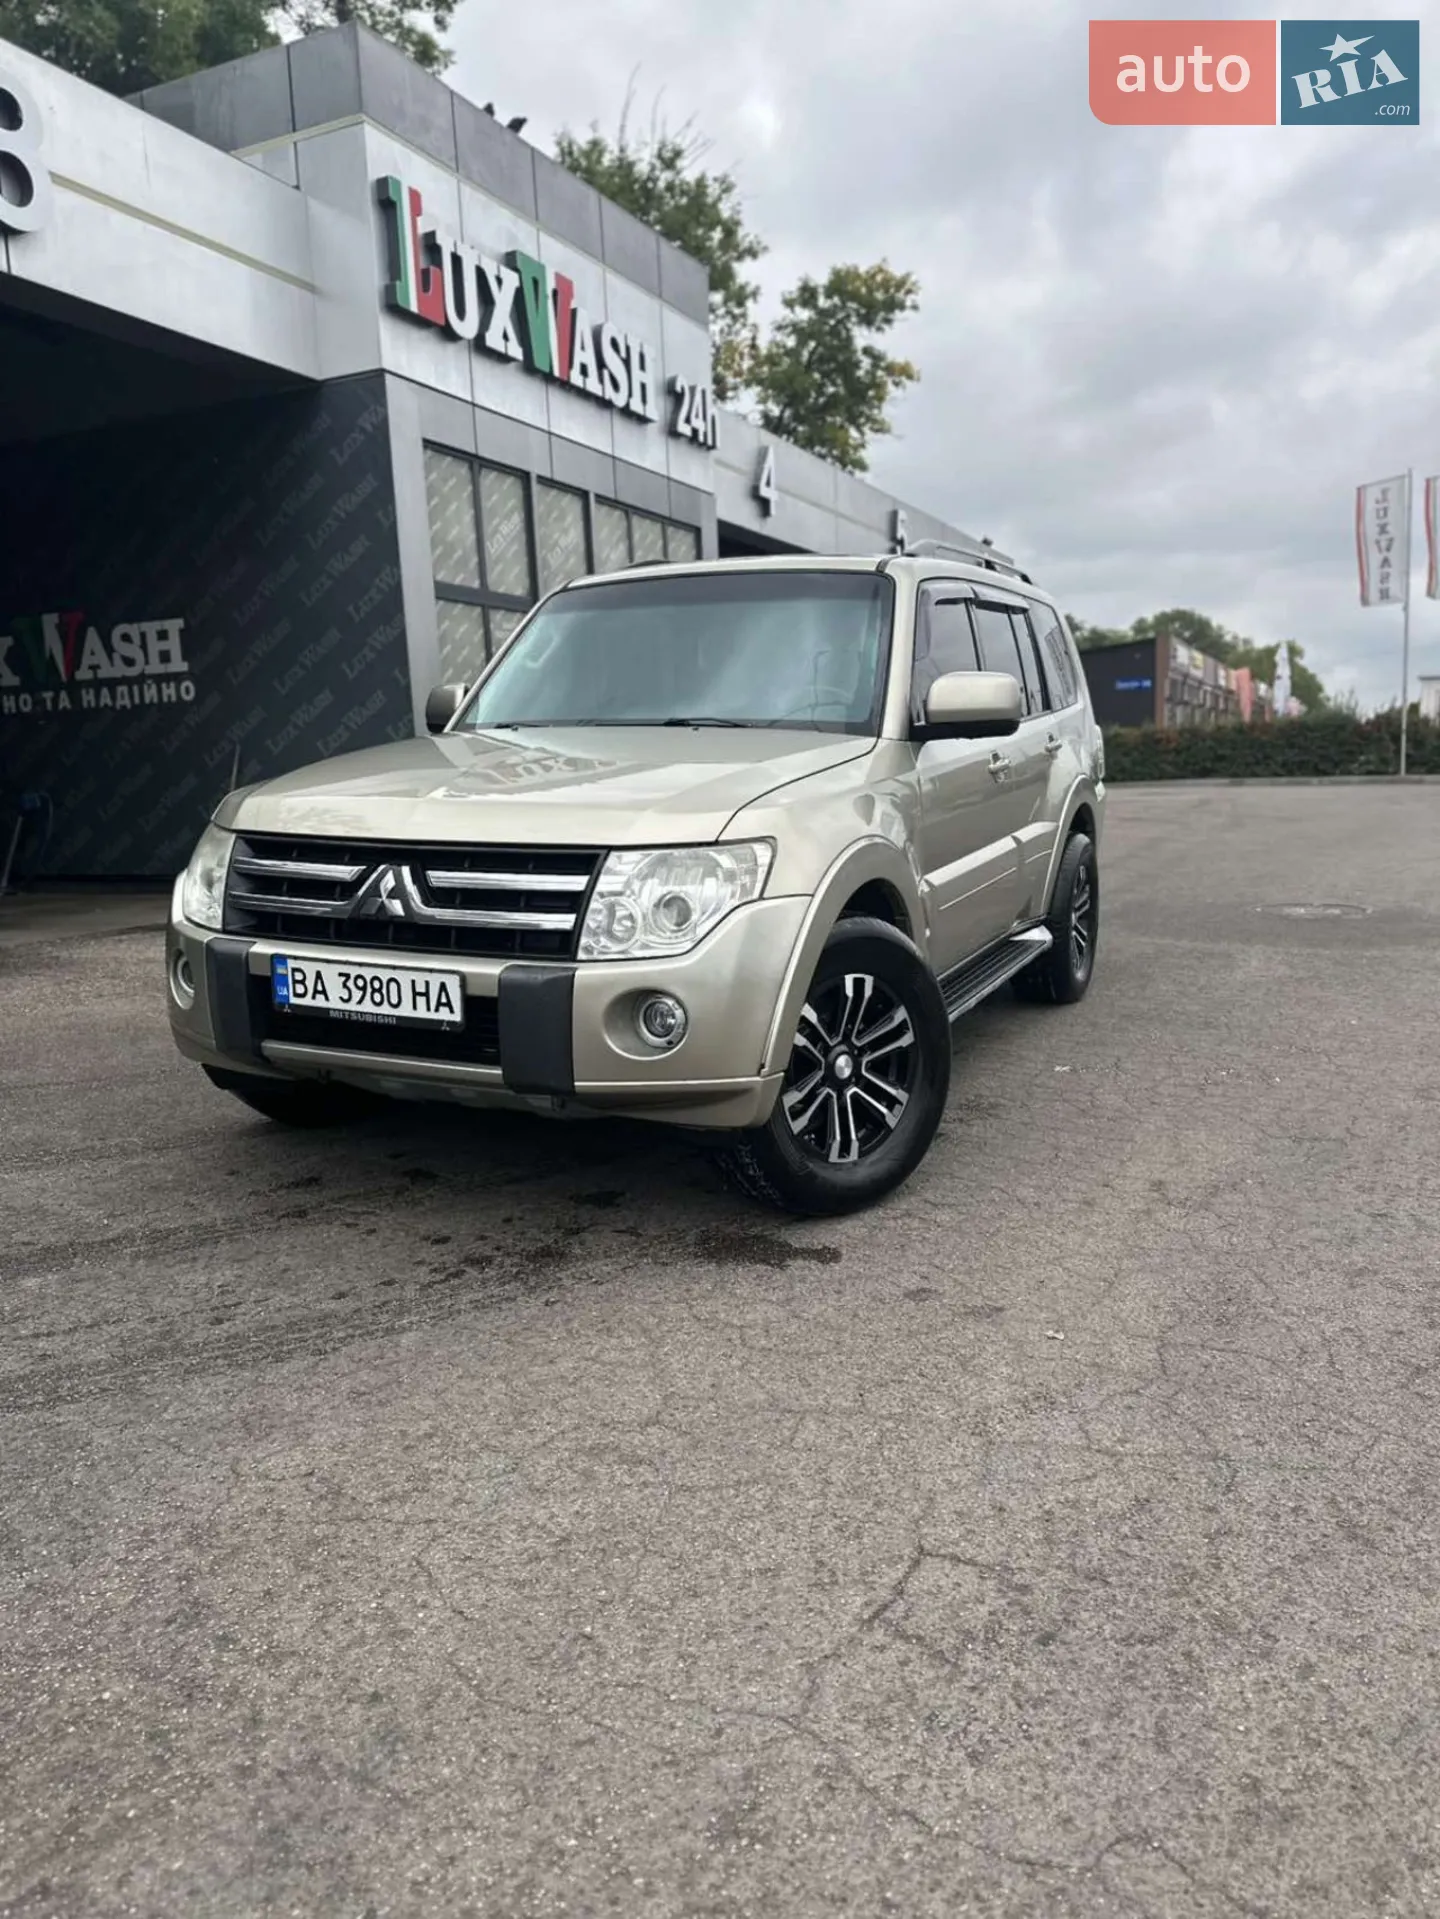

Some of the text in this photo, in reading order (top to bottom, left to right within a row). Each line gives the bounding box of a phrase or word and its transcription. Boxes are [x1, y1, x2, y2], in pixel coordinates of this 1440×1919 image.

[757, 446, 778, 516] 4
[42, 690, 71, 711] ТА
[81, 679, 197, 710] НАДІЙНО
[291, 967, 456, 1015] BA 3980 HA
[329, 1008, 397, 1026] MITSUBISHI
